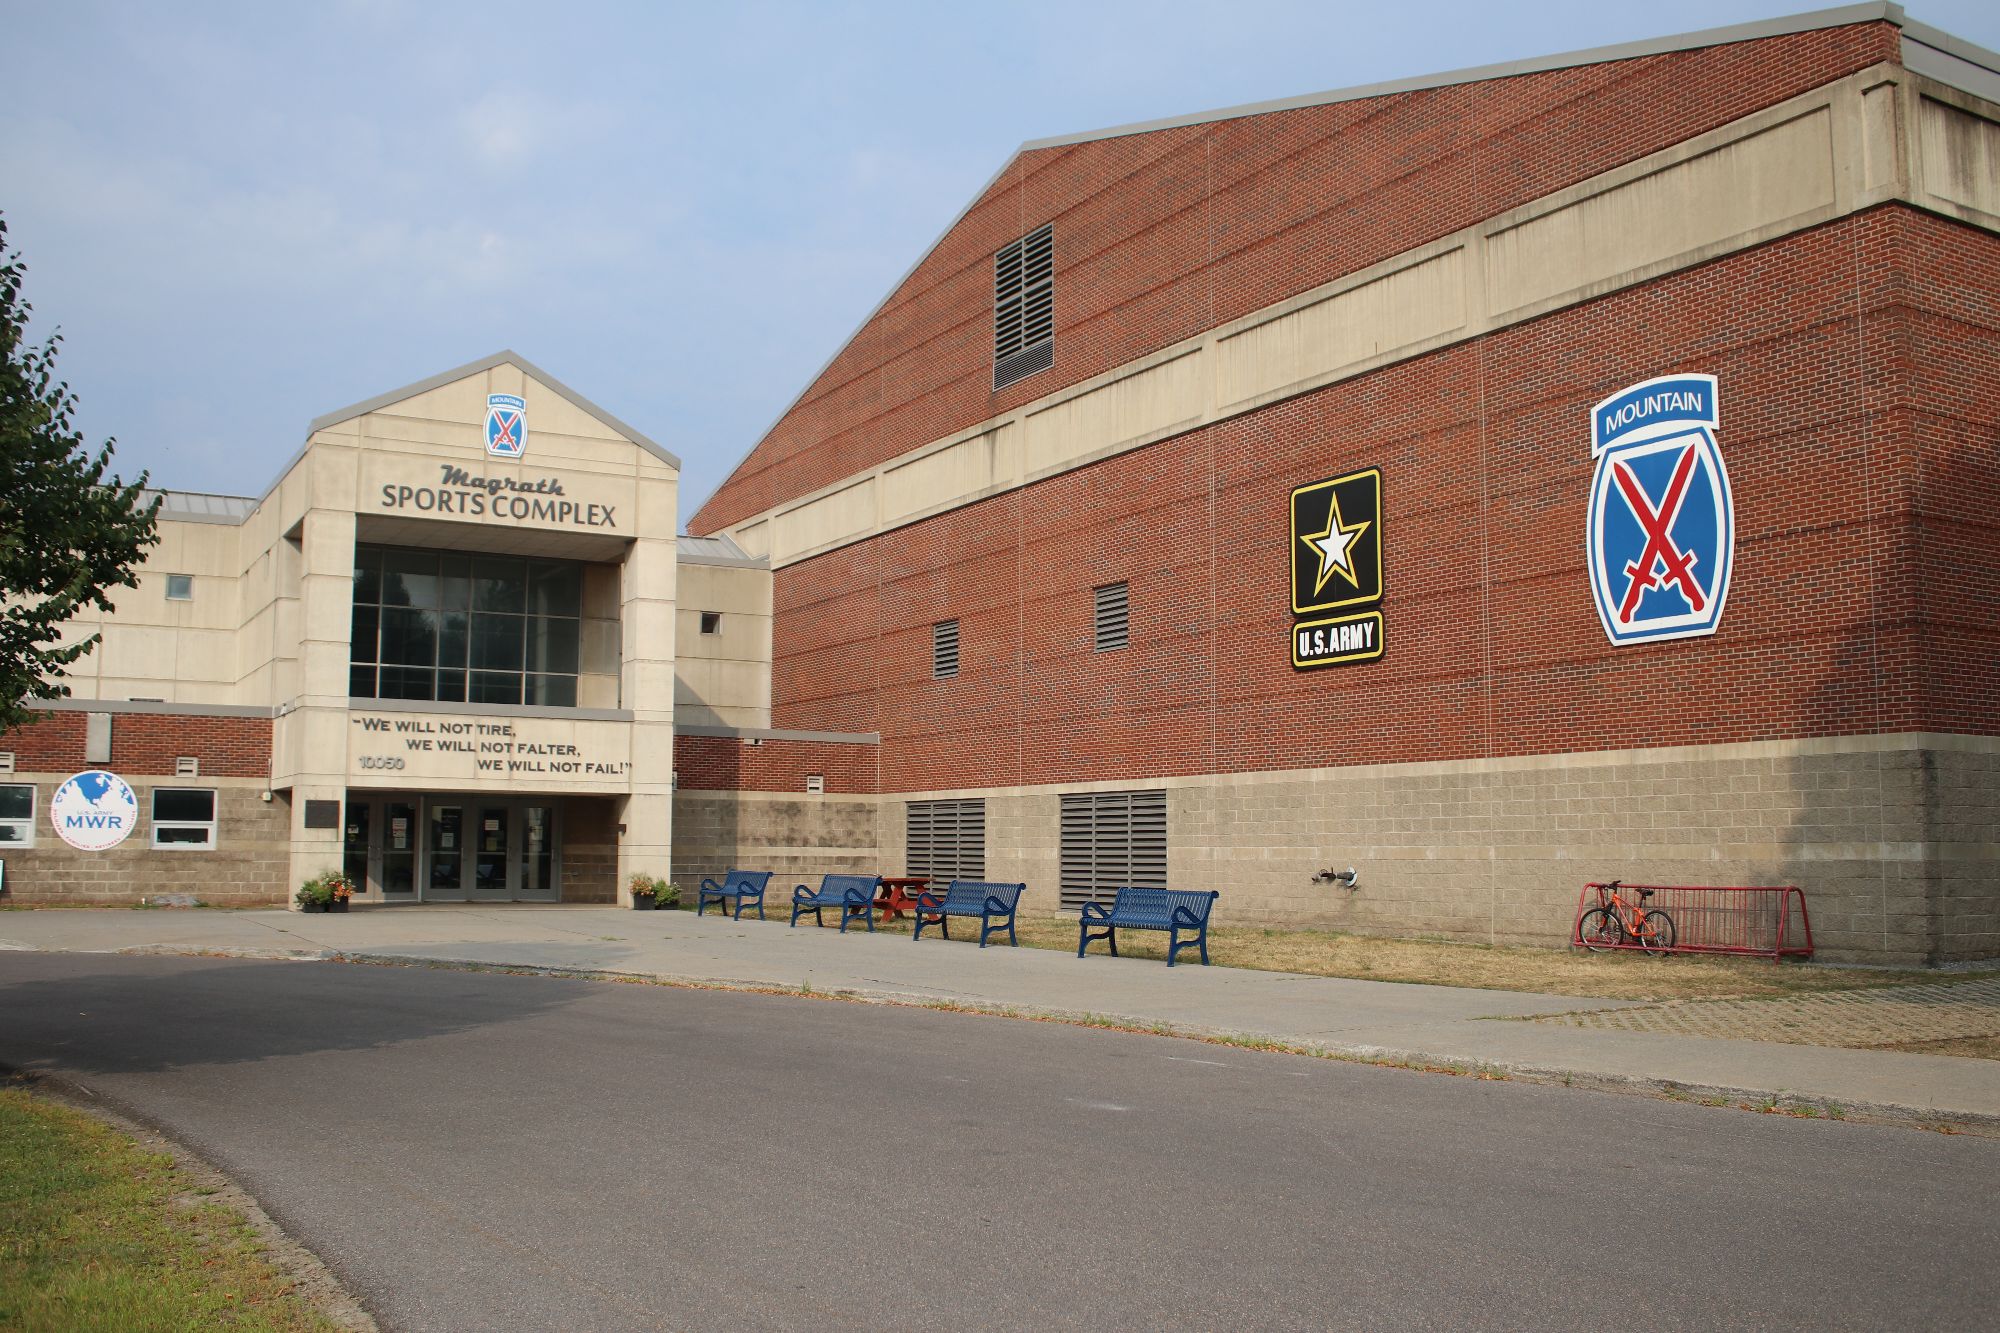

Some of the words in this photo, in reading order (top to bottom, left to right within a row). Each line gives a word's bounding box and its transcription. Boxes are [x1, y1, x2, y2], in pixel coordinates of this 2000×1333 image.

[491, 396, 522, 407] MOUNTAIN
[1605, 391, 1702, 435] MOUNTAIN
[440, 464, 565, 496] Magrath
[381, 484, 485, 515] SPORTS
[491, 495, 617, 528] COMPLEX
[395, 720, 435, 733] WILL
[440, 722, 473, 735] NOT
[476, 723, 516, 738] TIRE,
[406, 739, 433, 751] WE
[437, 740, 476, 753] WILL
[480, 742, 514, 754] NOT
[517, 743, 581, 758] FALTER,
[359, 755, 405, 770] 10050
[477, 760, 503, 771] WE
[508, 760, 546, 772] WILL
[550, 762, 582, 773] NOT
[66, 815, 122, 829] MWR
